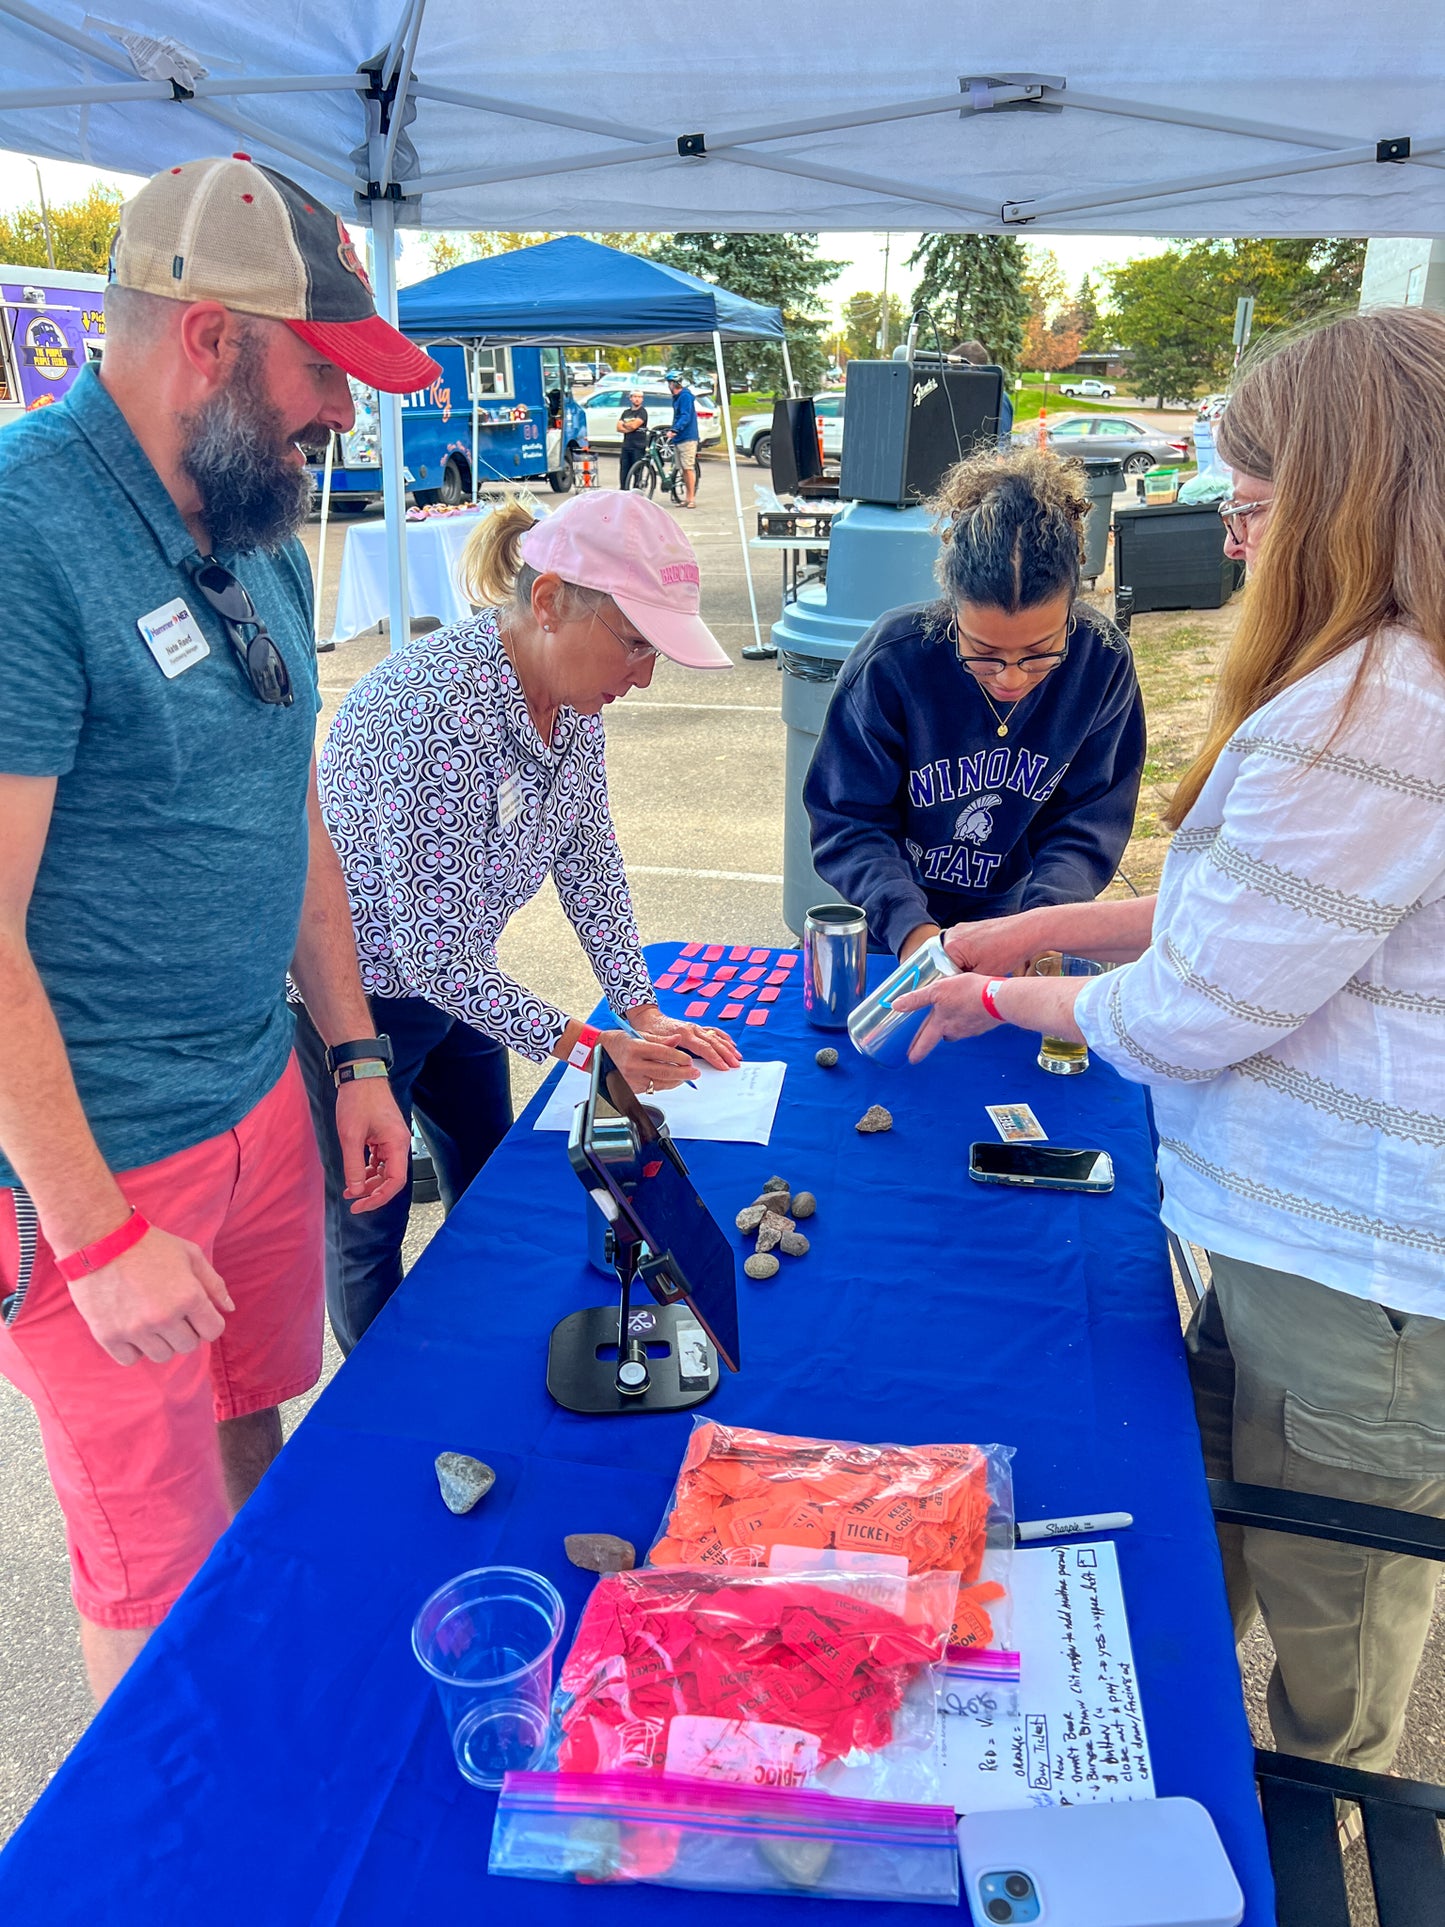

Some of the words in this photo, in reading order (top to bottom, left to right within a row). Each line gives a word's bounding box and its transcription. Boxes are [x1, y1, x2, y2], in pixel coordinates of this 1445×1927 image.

[1044, 1523, 1083, 1537] Sharpie
[807, 1629, 840, 1661] TICKET
[1033, 1761, 1050, 1788] Buy
